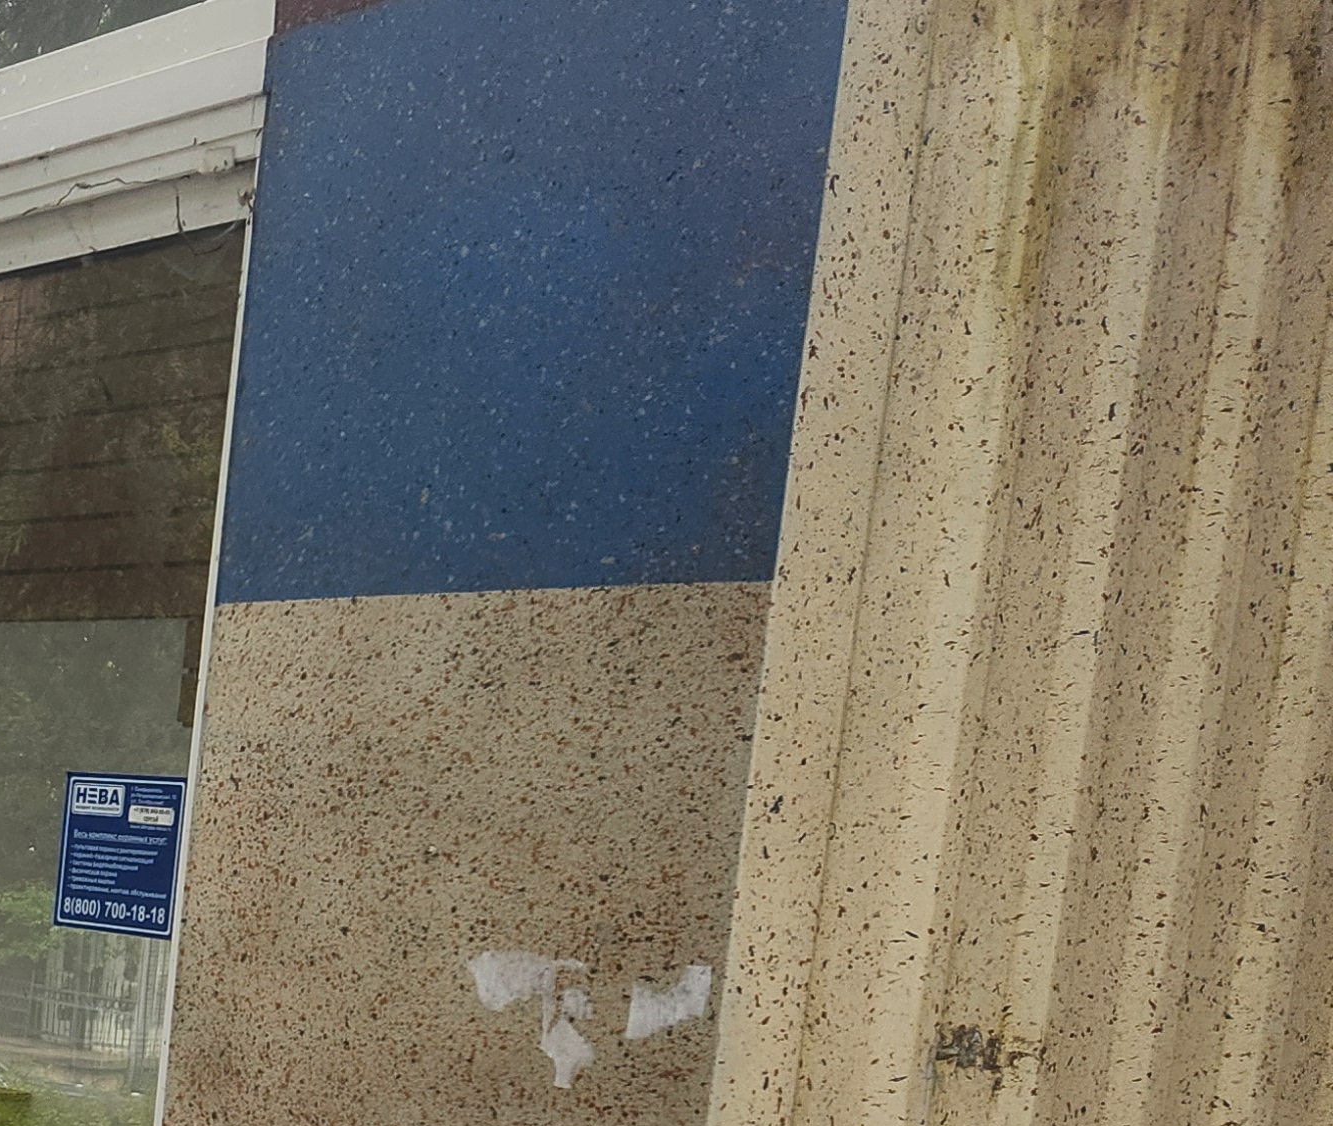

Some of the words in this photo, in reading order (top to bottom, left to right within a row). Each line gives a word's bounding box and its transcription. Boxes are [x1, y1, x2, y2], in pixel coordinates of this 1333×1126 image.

[75, 787, 120, 806] НЕВА
[64, 897, 101, 919] 8(800)
[104, 901, 166, 925] 700-18-18
